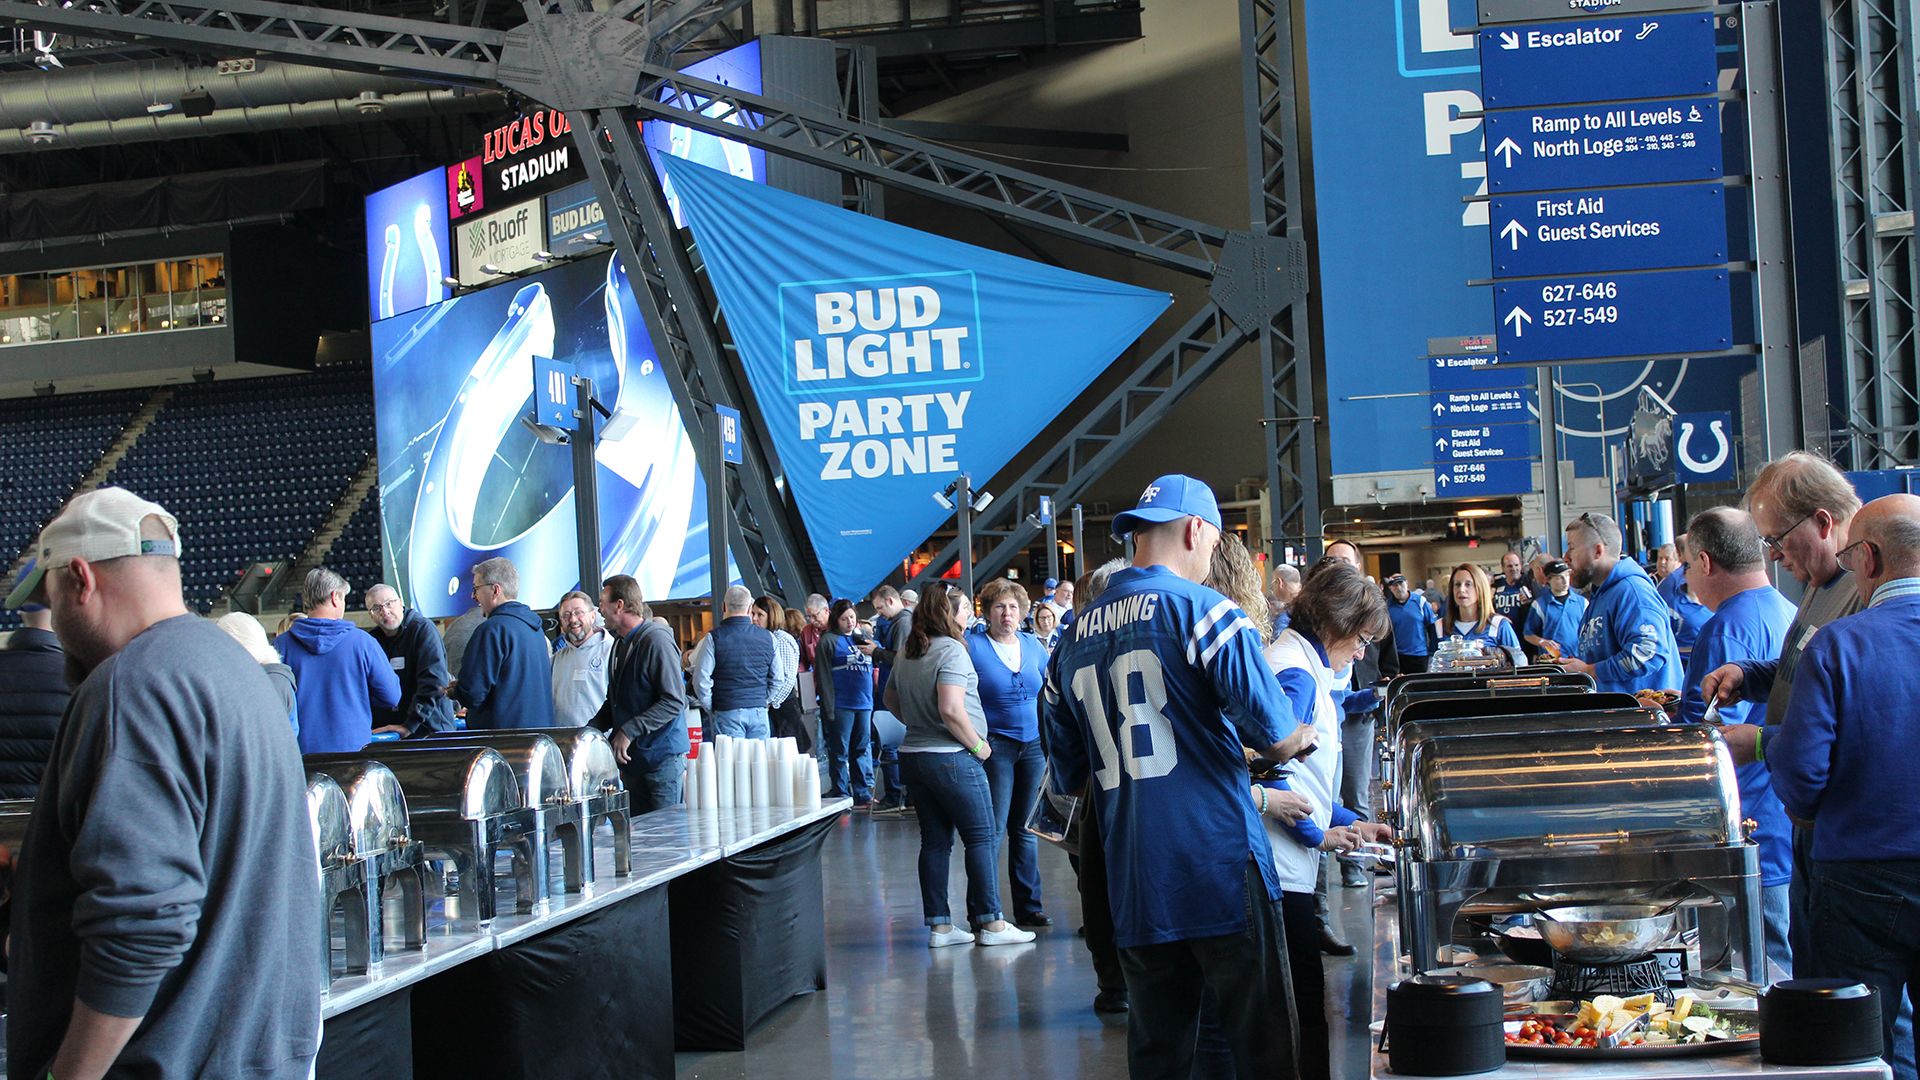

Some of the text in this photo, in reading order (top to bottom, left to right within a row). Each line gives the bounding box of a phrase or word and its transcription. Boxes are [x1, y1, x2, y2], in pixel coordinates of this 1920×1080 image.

[1569, 0, 1621, 8] STADIUM
[1527, 28, 1622, 48] Escalator
[1532, 107, 1682, 134] Ramp to All Levels
[483, 111, 544, 165] LUCAS
[1661, 141, 1675, 149] 343
[1682, 140, 1696, 148] 349
[1681, 132, 1694, 140] 453
[1533, 138, 1623, 158] North Loge
[501, 146, 568, 191] STADIUM
[1536, 197, 1604, 217] First Aid
[488, 208, 528, 246] Ruoff
[552, 210, 579, 236] BUD
[1537, 220, 1660, 242] Guest Services
[489, 240, 530, 265] MORTGAGE
[1542, 282, 1617, 303] 627-646
[815, 286, 941, 335] BUD
[1543, 305, 1618, 327] 527-549
[794, 326, 969, 382] LIGHT
[1448, 358, 1488, 367] Escalator
[1449, 391, 1512, 403] Ramp to All Levels
[798, 391, 972, 440] PARTY
[1450, 404, 1470, 413] North
[1471, 403, 1488, 413] Loge
[1451, 429, 1480, 437] Elevator
[1452, 439, 1480, 448] First Aid
[819, 434, 959, 481] ZONE
[1452, 448, 1504, 458] Guest Services
[1453, 463, 1486, 473] 627-646
[1453, 474, 1486, 483] 527-549
[1075, 593, 1159, 642] MANNING
[1071, 649, 1178, 791] 18
